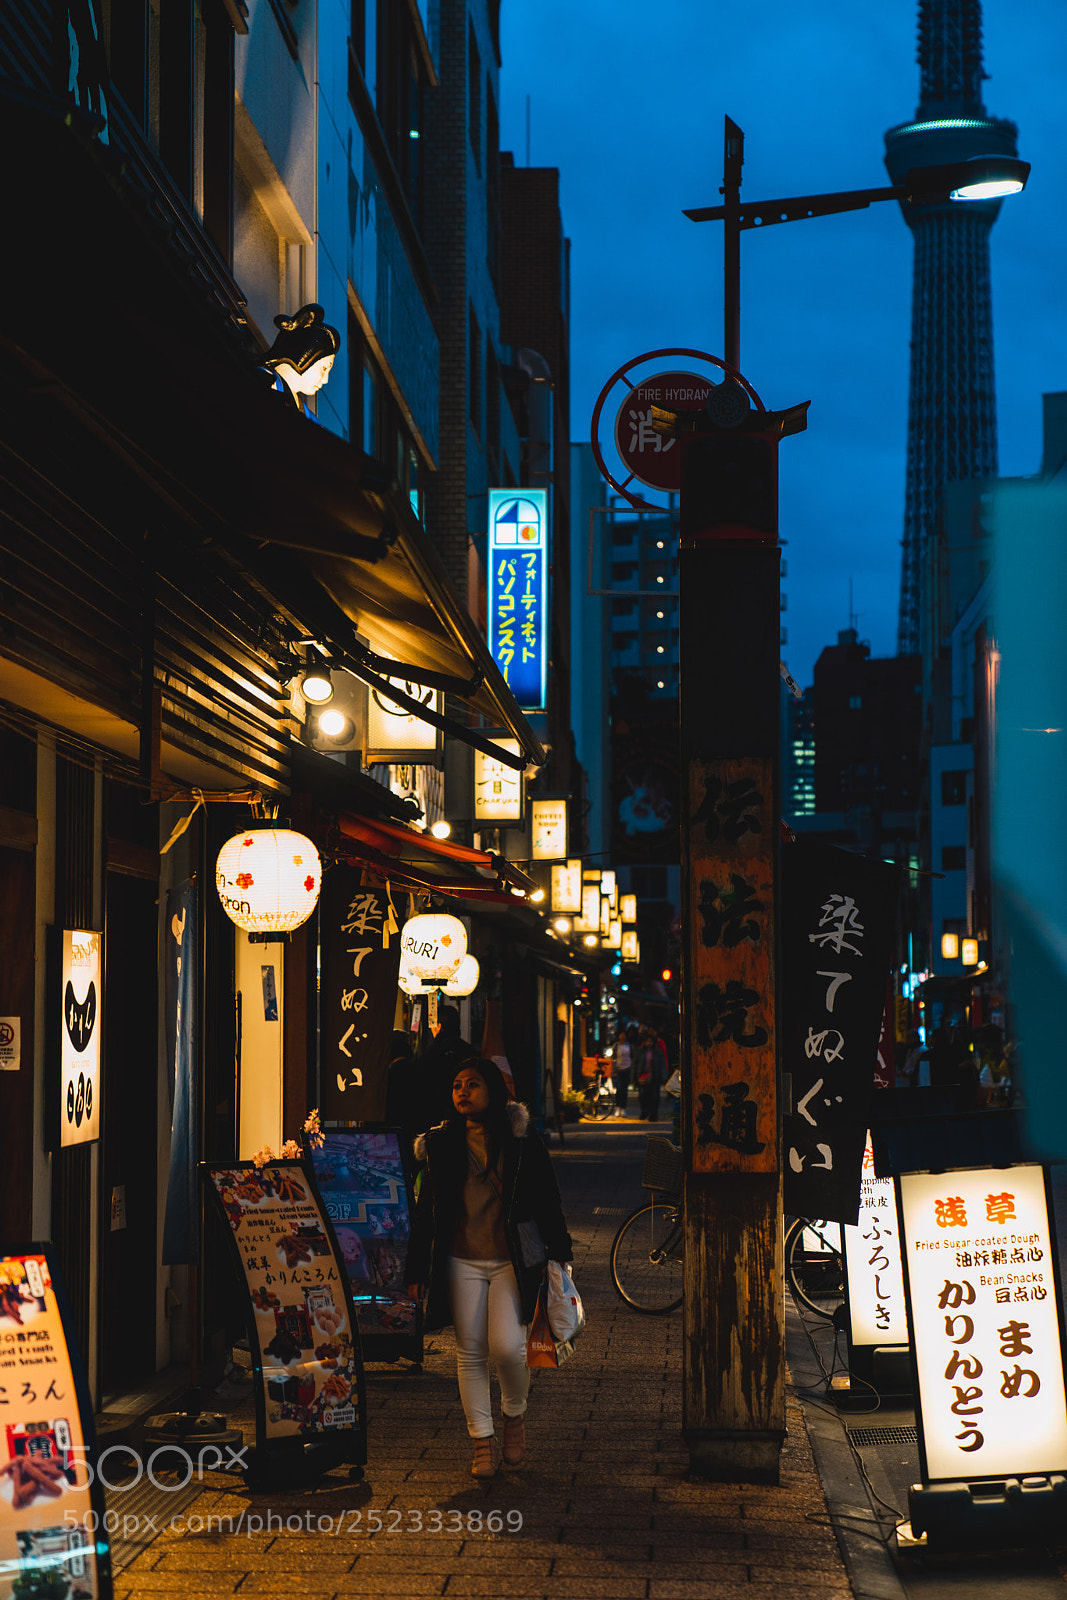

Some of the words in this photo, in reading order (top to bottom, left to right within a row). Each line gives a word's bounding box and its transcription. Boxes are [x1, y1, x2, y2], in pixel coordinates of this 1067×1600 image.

[637, 388, 661, 401] FIRE
[520, 552, 537, 664] フォーティネット
[336, 893, 383, 1092] 染てぬぐい
[788, 893, 865, 1174] 染てぬぐい
[325, 1202, 352, 1220] 2F
[934, 1191, 1018, 1229] 浅草
[915, 1238, 940, 1251] Fried
[943, 1235, 1008, 1251] Sugar-coated
[1010, 1232, 1040, 1245] Dough
[247, 1255, 271, 1271] 浅草
[265, 1267, 338, 1285] かりんころん
[862, 1216, 893, 1330] ふろしき
[980, 1274, 1005, 1286] Bean
[1007, 1272, 1044, 1284] Snacks
[995, 1286, 1047, 1304] 豆点心
[937, 1279, 985, 1453] かりんとう
[997, 1320, 1041, 1399] まめ
